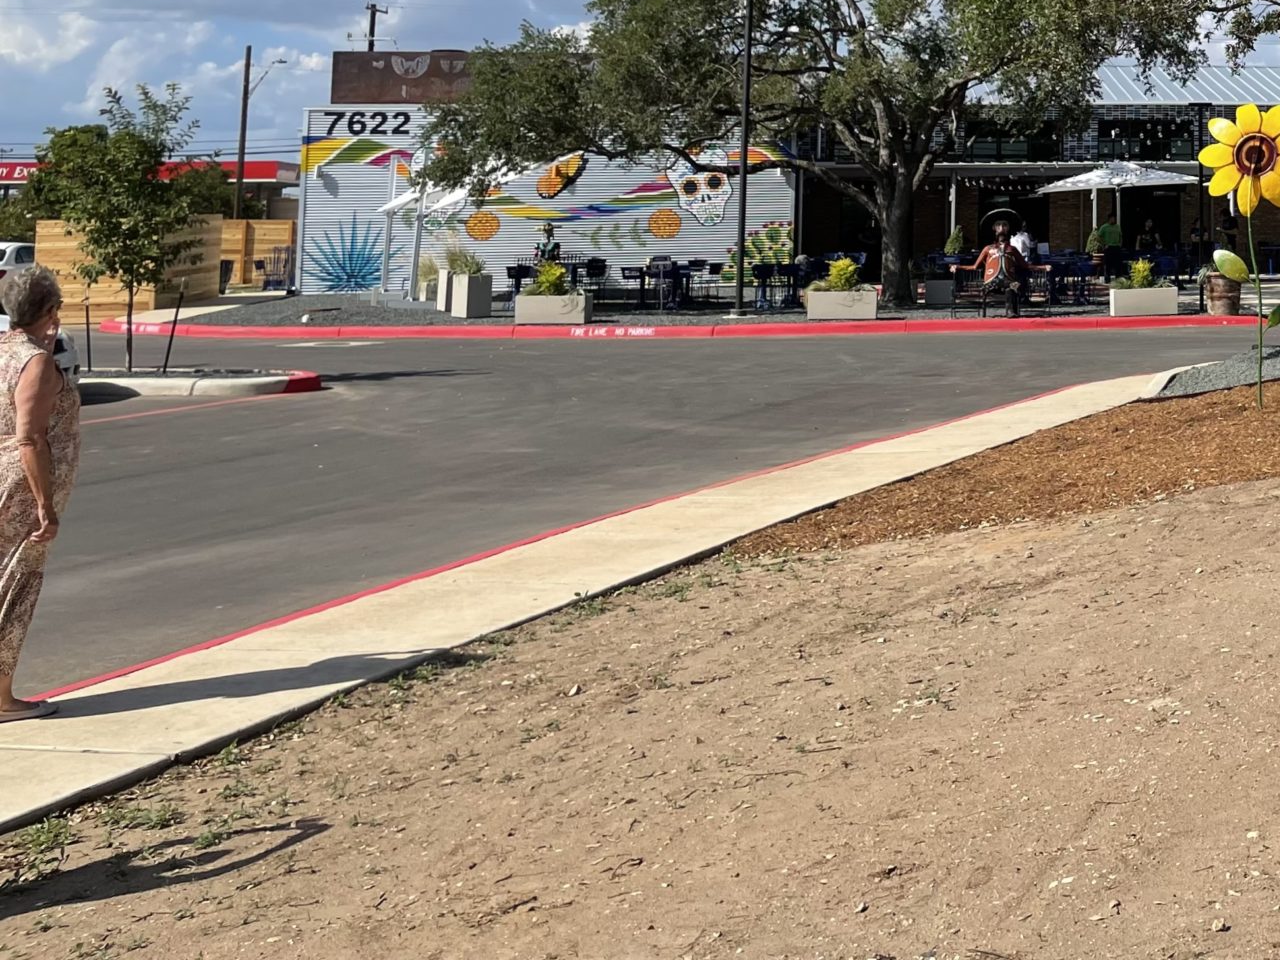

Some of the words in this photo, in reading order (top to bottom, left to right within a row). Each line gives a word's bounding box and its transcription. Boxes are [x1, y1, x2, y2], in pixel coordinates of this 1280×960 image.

[324, 112, 411, 136] 7622
[570, 327, 586, 336] FIRE
[588, 327, 608, 336] LANE
[614, 327, 625, 336] NO
[627, 327, 656, 336] PARKING
